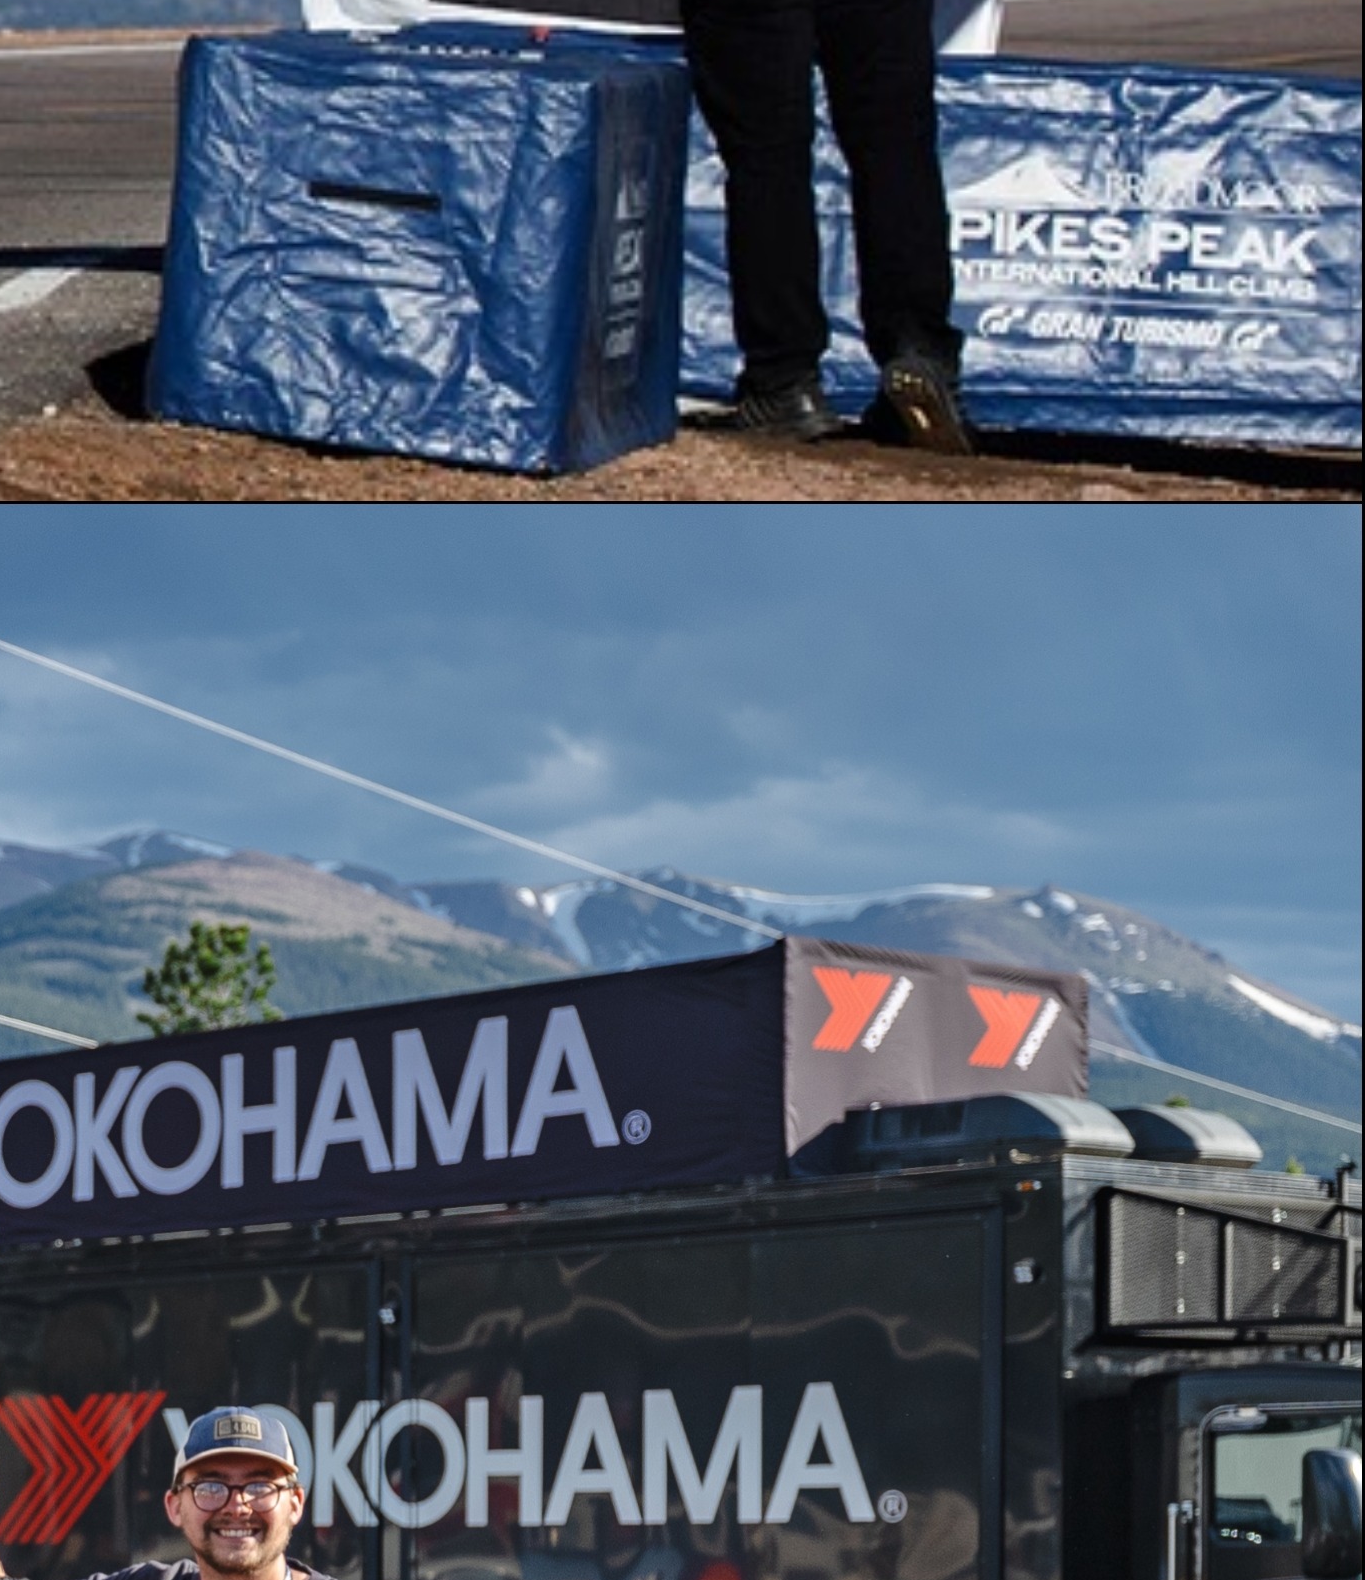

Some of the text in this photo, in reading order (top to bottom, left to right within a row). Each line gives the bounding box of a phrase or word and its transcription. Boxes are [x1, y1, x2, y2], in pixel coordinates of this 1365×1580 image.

[950, 210, 1320, 276] PIKES PEAK
[953, 259, 1159, 292] NTERNATIONAL
[1167, 277, 1224, 295] HILL
[1028, 307, 1223, 348] GRAN TURISMO
